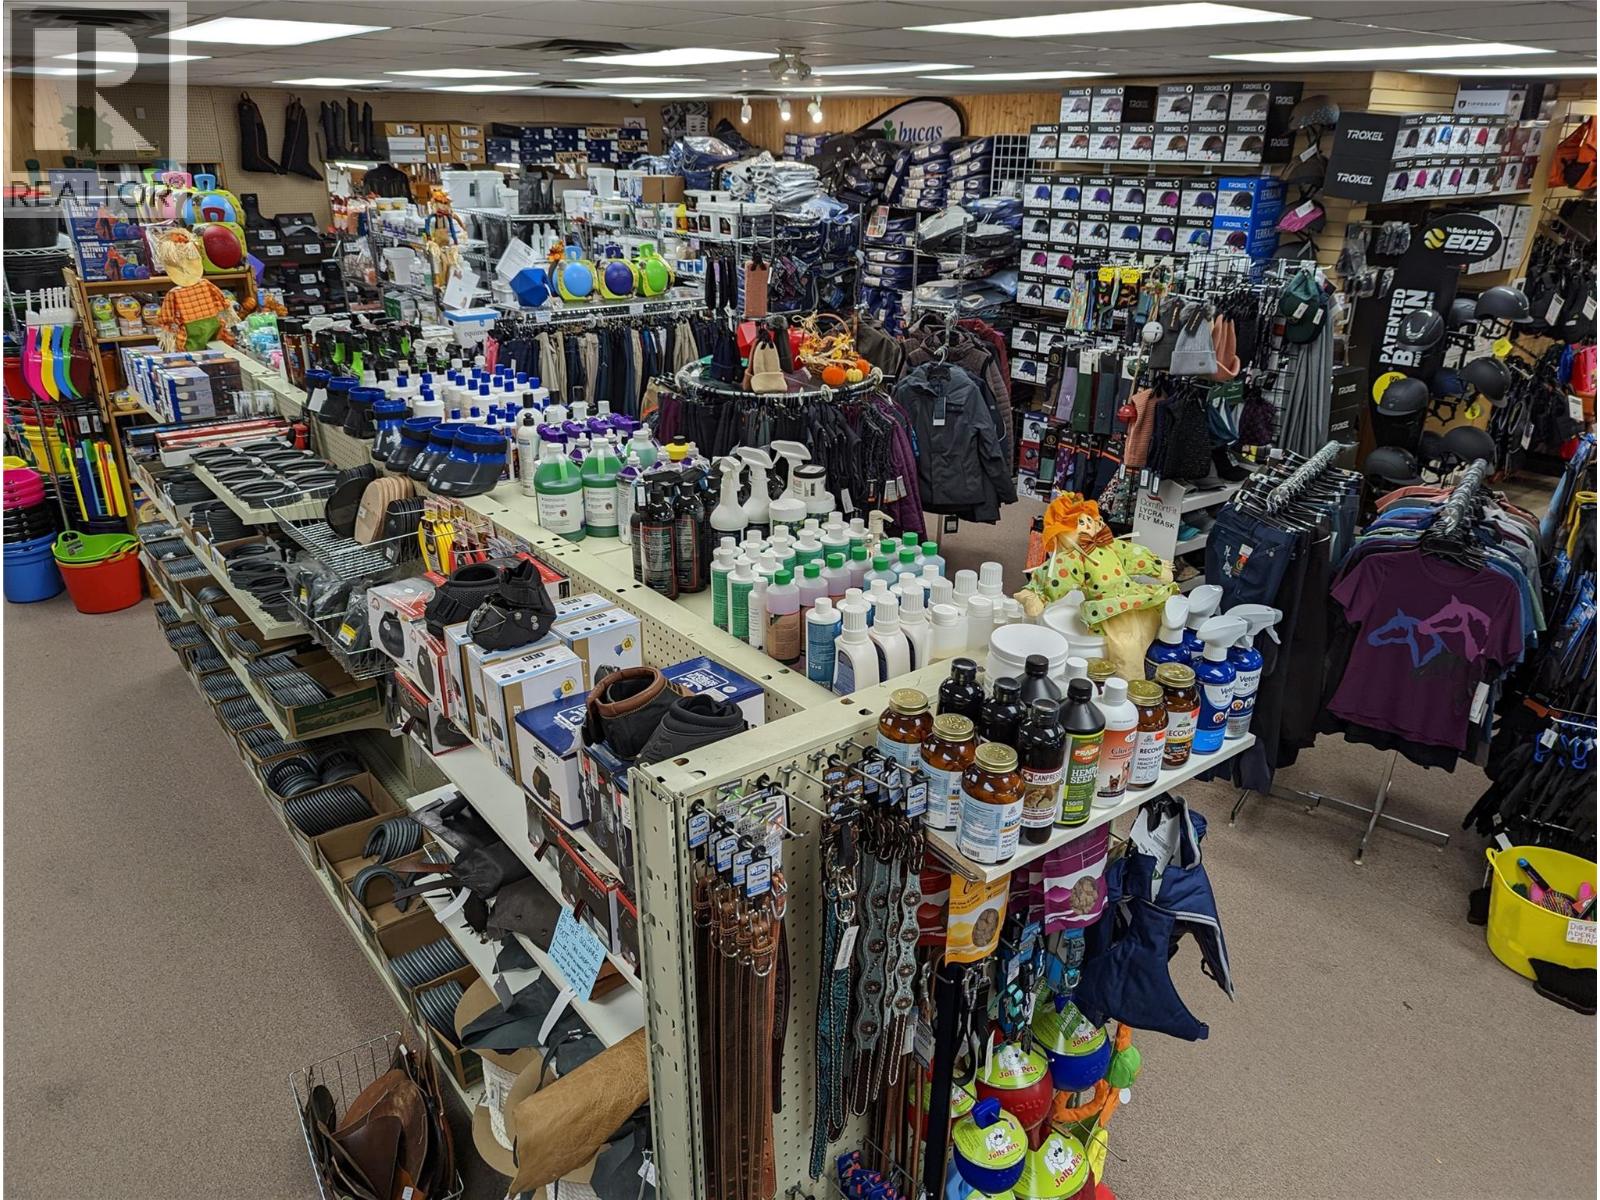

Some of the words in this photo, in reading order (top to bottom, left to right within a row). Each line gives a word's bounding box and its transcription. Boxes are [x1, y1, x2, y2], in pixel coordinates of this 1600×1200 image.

[899, 121, 943, 142] bucas
[1347, 129, 1384, 141] TROXEL
[1336, 173, 1373, 185] TROXEL
[1379, 288, 1407, 364] PATENTED
[1138, 512, 1151, 521] FLY
[1153, 517, 1175, 529] MASK
[1139, 506, 1163, 519] LYCRA
[1072, 1033, 1090, 1048] Jolly
[1000, 1069, 1019, 1079] Jolly
[1022, 1065, 1037, 1074] Pets
[988, 1148, 1005, 1161] Jolly
[1005, 1142, 1020, 1153] Pets
[1054, 1168, 1073, 1188] Jolly
[1070, 1152, 1083, 1168] Pets
